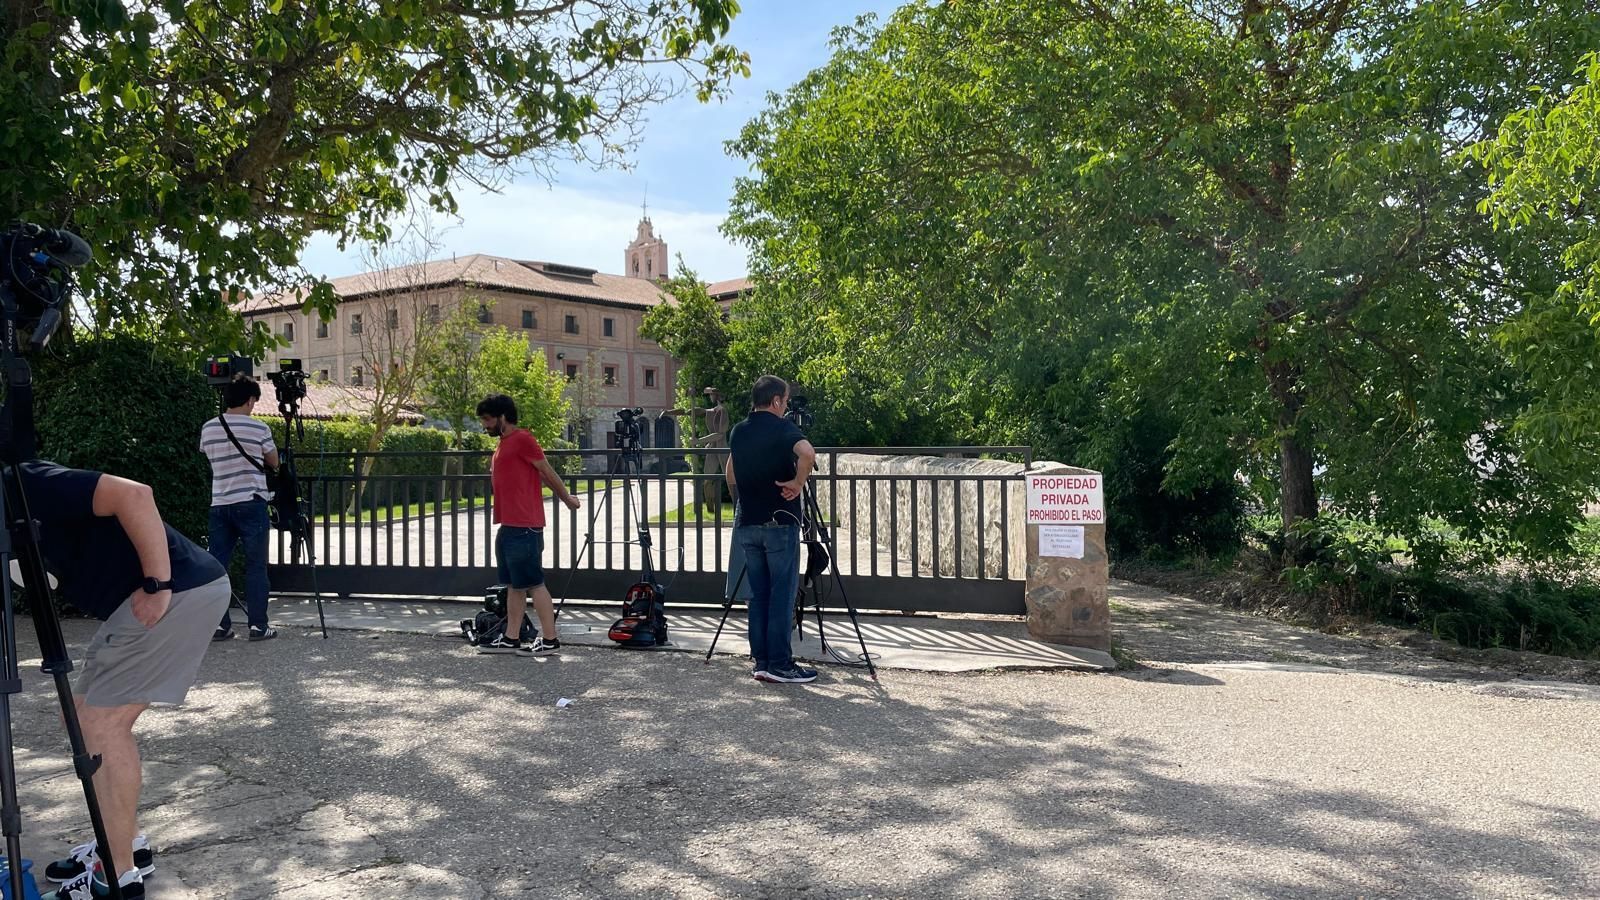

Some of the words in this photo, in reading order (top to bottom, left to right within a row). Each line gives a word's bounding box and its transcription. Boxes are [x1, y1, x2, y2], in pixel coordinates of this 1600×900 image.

[1032, 478, 1097, 489] PROPIEDAD
[1041, 494, 1089, 505] PRIVADA
[1029, 509, 1069, 521] PROHIBIDO
[1071, 509, 1080, 521] EL
[1082, 509, 1102, 521] PASO
